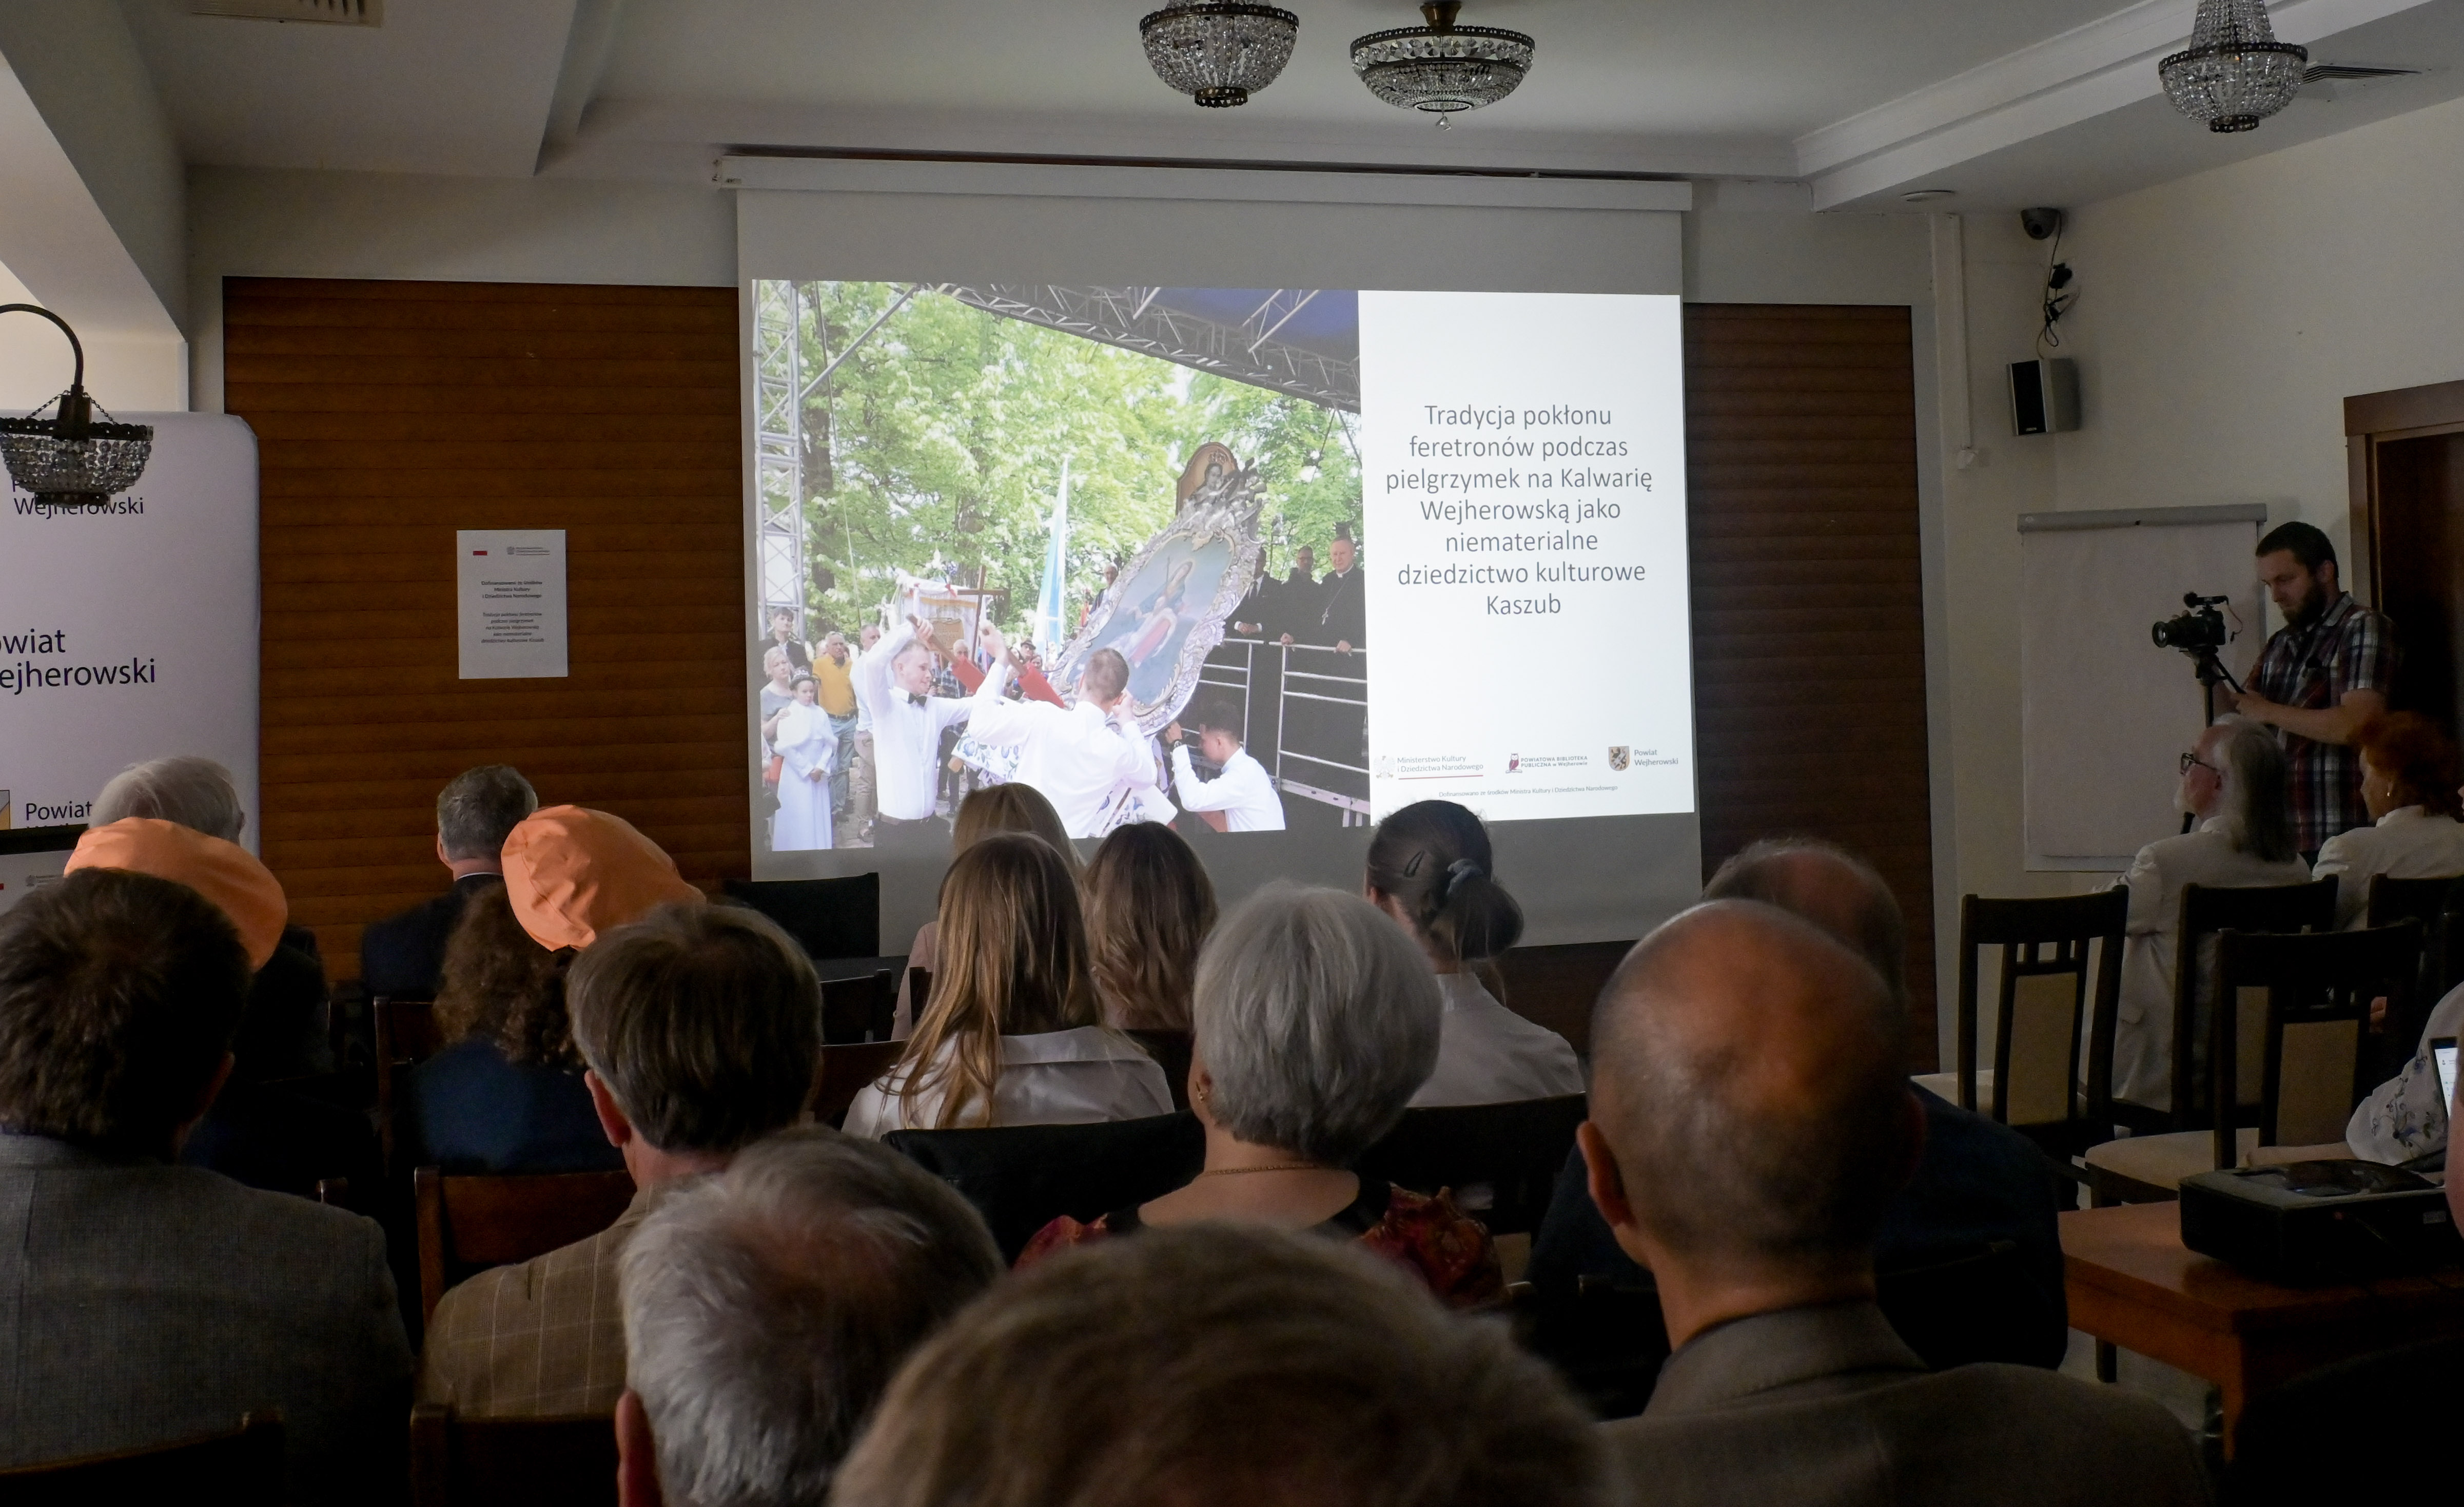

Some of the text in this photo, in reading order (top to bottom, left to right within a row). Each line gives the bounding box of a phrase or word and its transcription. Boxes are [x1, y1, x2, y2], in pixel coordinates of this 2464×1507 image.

[1424, 404, 1611, 430] Tradycja pokłonu
[1409, 435, 1628, 461] feretronów podczas
[1386, 467, 1652, 494] pielgrzymek na Kalwarię
[1420, 497, 1620, 525] Wejherowską jako
[1446, 529, 1598, 552] niematerialne
[1398, 561, 1646, 585] dziedzictwo kulturowe
[1487, 592, 1561, 615] Kaszub
[0, 628, 66, 654] wiat
[1634, 758, 1679, 767] Wejherowski
[26, 801, 92, 821] Powiat
